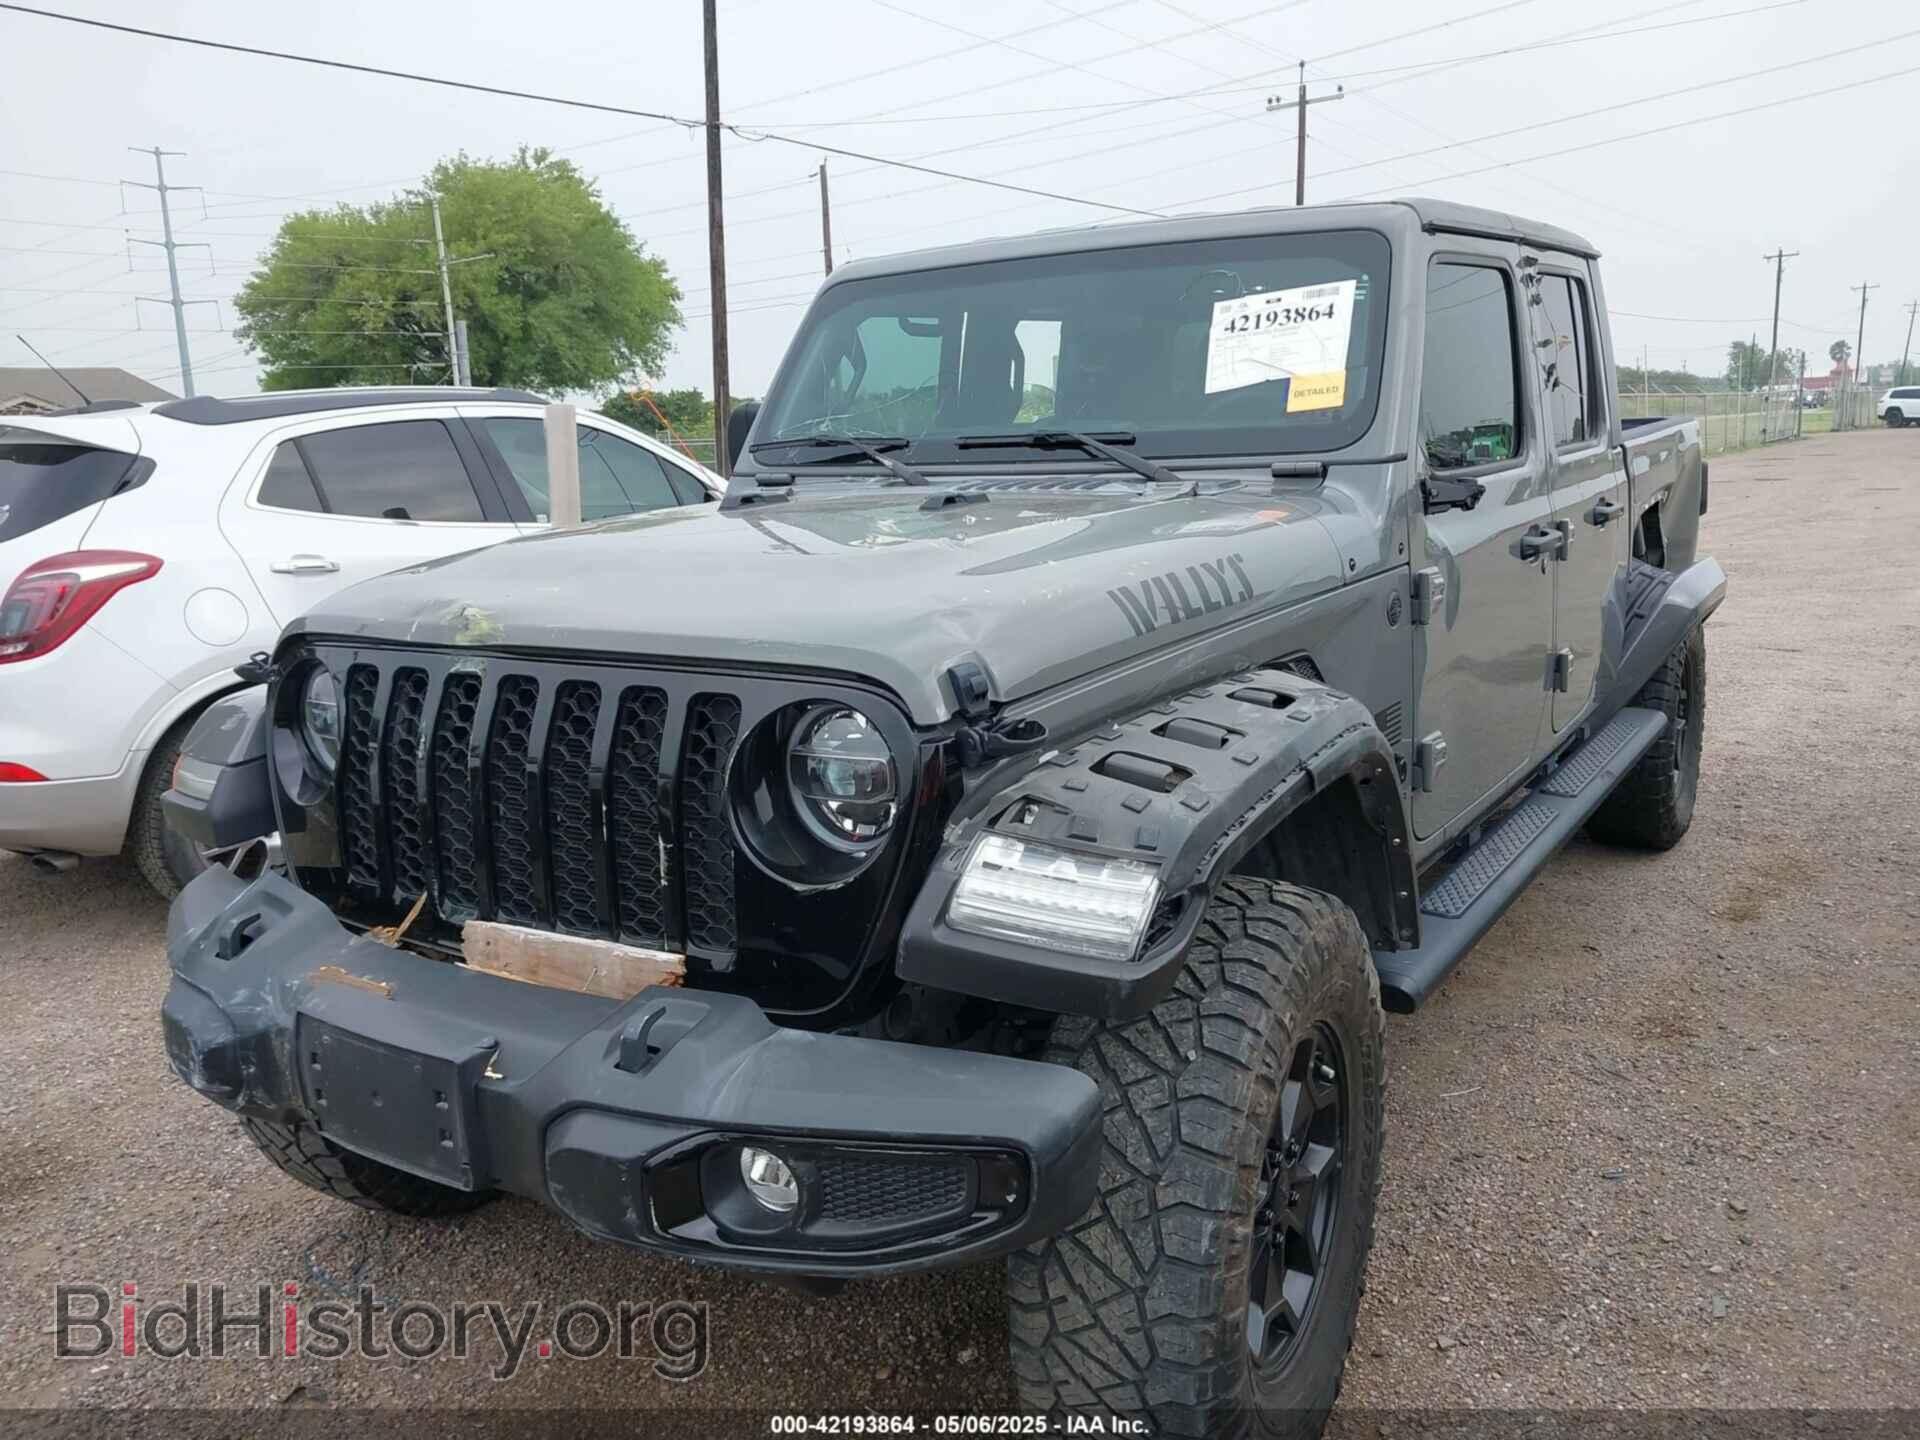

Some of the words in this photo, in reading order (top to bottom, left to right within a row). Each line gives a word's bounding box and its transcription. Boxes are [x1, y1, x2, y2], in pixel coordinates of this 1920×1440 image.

[1224, 303, 1335, 333] 42193864
[1293, 386, 1339, 398] DETAILED
[1106, 553, 1254, 637] WILLYS
